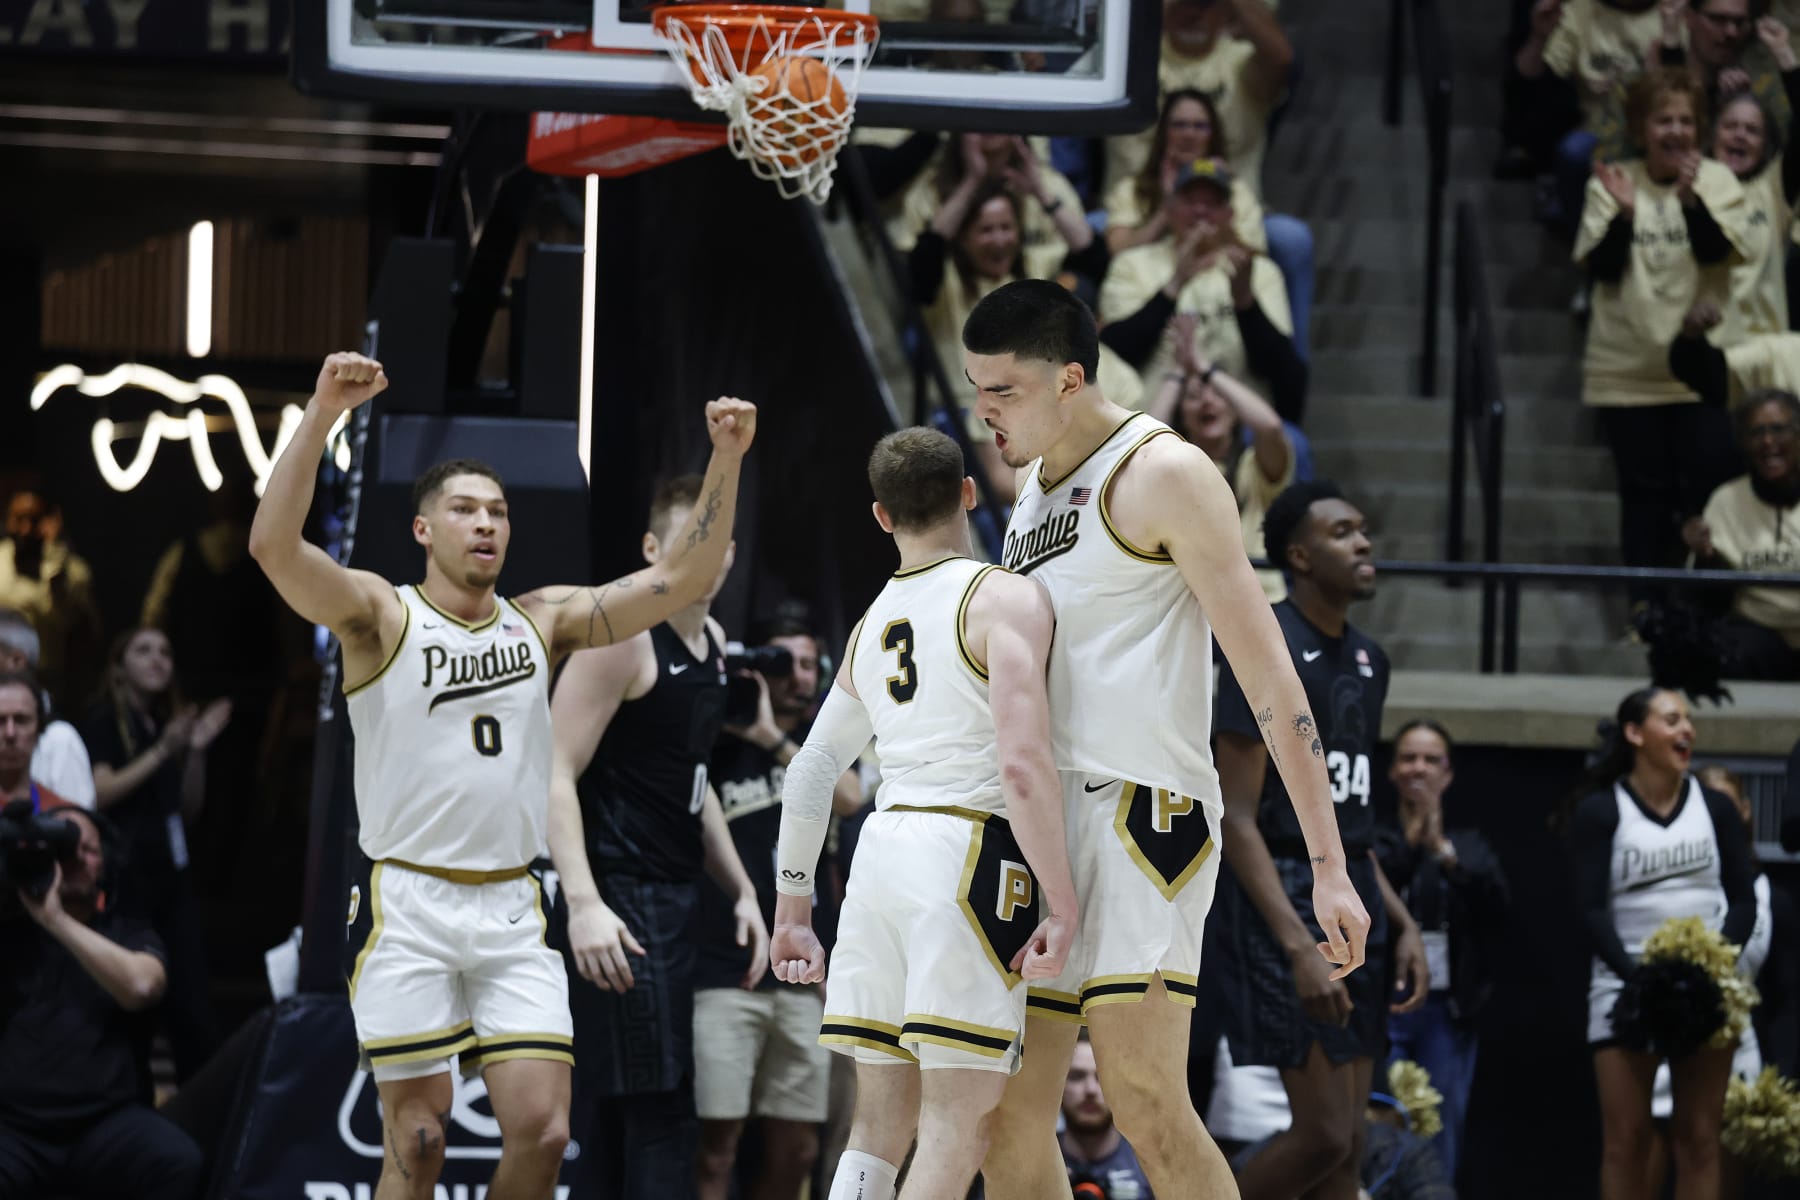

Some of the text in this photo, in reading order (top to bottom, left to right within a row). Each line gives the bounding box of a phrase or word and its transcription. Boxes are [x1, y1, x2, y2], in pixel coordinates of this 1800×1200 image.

[1003, 507, 1079, 573] Purdue
[421, 640, 536, 692] Purdue
[880, 617, 918, 705] 3
[471, 714, 502, 757] 0
[1327, 751, 1370, 807] 34
[1151, 786, 1193, 832] P
[1620, 838, 1714, 880] Purdue
[996, 859, 1032, 921] P
